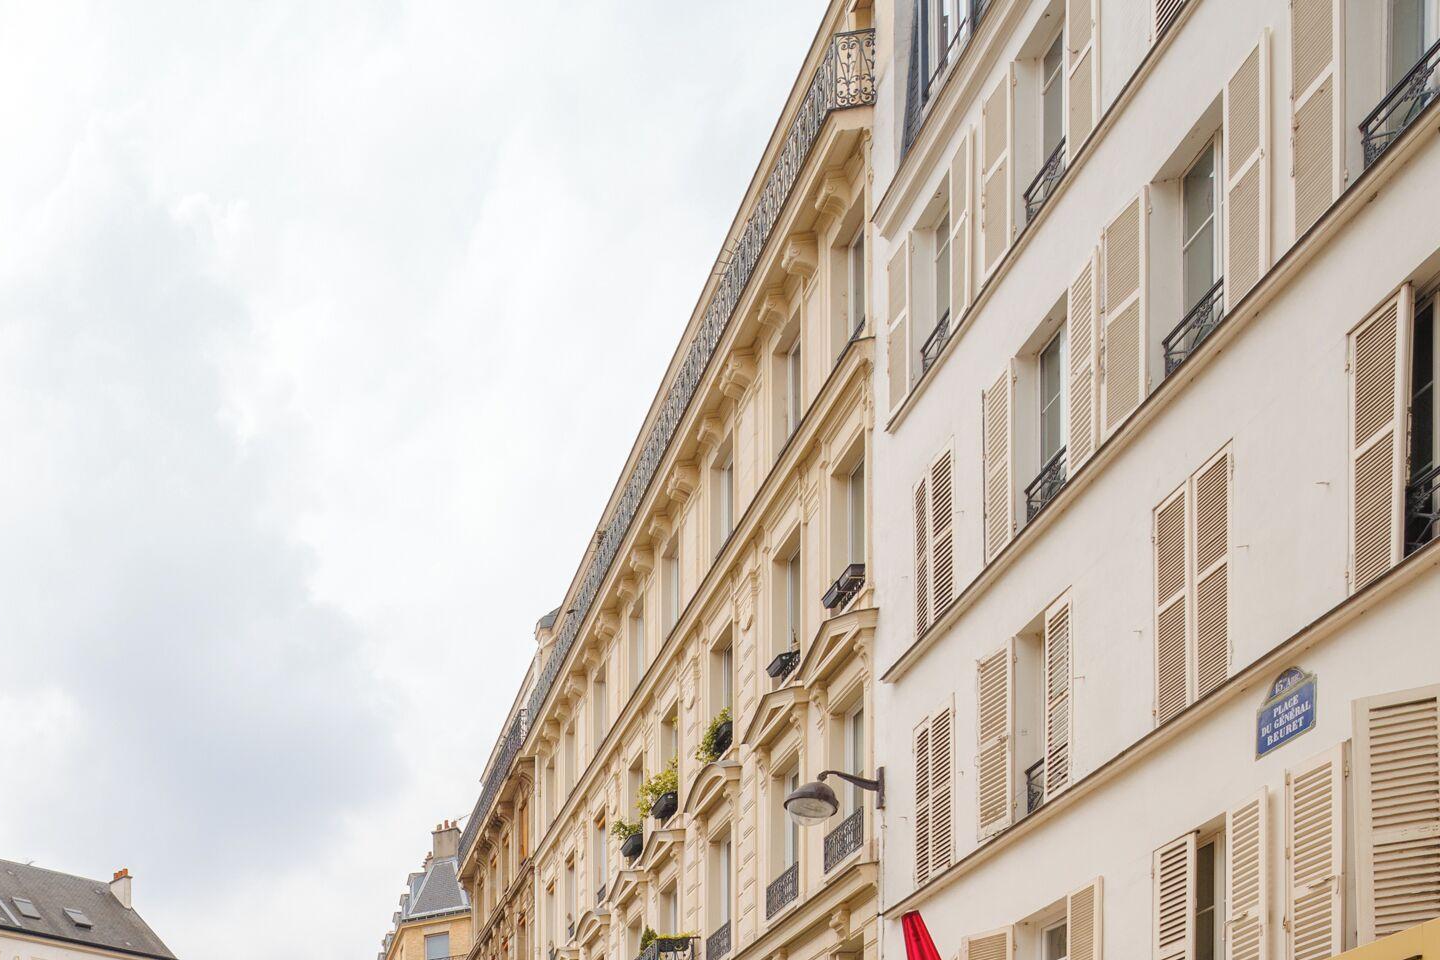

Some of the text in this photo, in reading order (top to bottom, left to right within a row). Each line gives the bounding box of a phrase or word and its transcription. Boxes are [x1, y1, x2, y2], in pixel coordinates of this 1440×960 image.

[1273, 694, 1299, 718] PLACE
[1261, 723, 1272, 737] DU
[1266, 716, 1305, 746] BEURET
